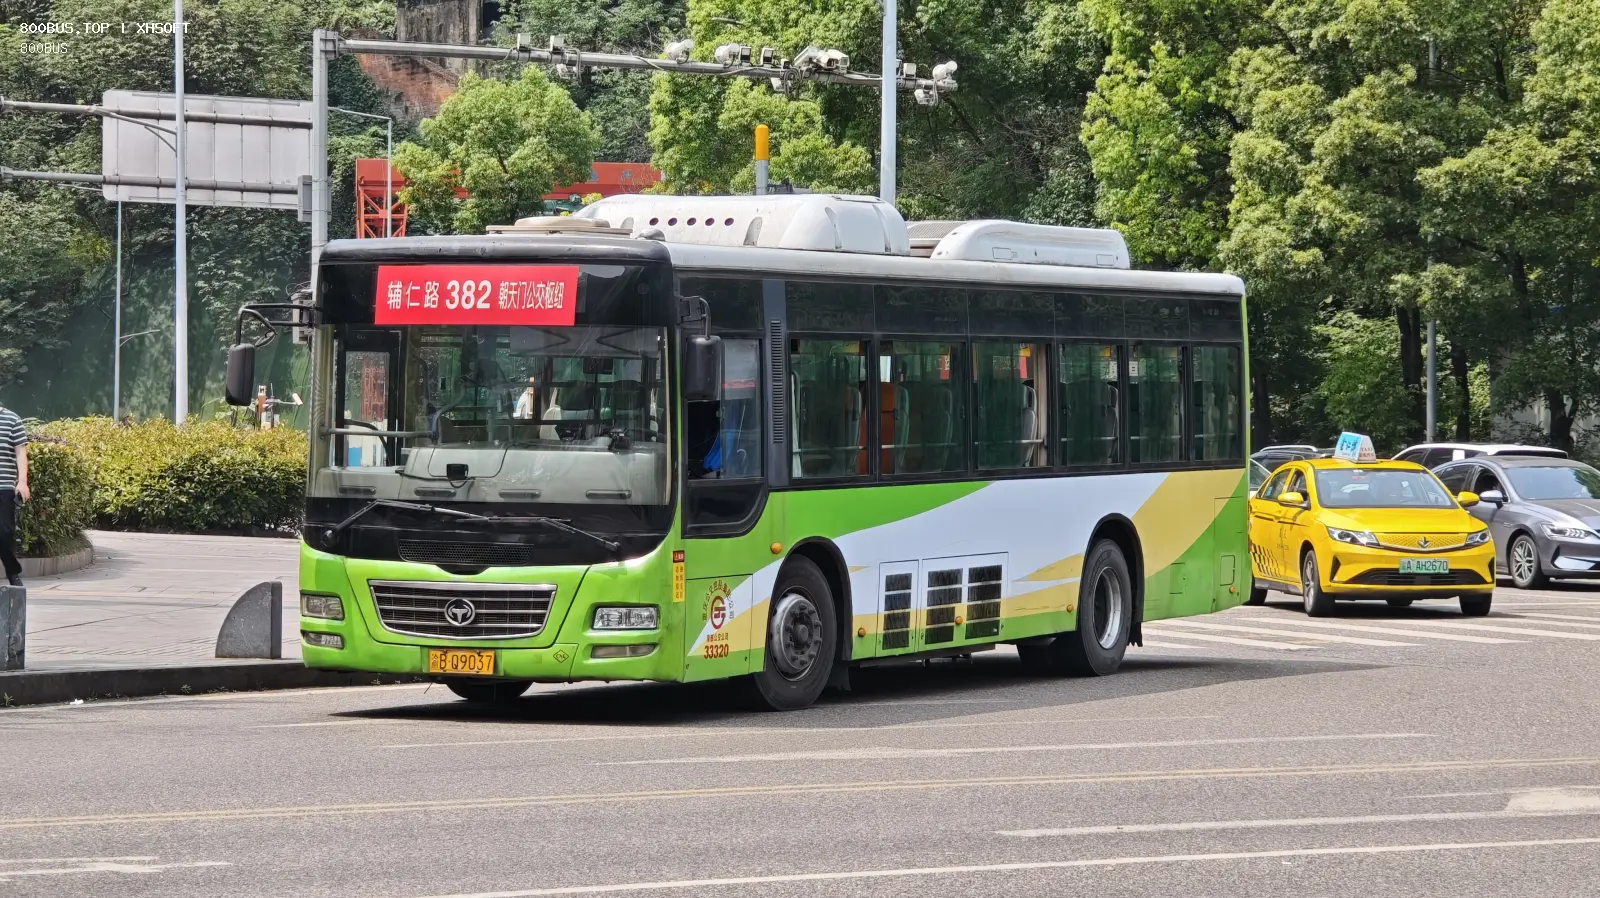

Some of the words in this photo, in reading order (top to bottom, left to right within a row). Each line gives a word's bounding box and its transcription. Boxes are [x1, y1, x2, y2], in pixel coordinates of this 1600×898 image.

[387, 280, 440, 310] 辅仁路
[445, 279, 492, 310] 382
[498, 280, 565, 310] 朝天门公交枢纽
[1415, 560, 1448, 571] AH2670
[703, 643, 729, 660] 33320
